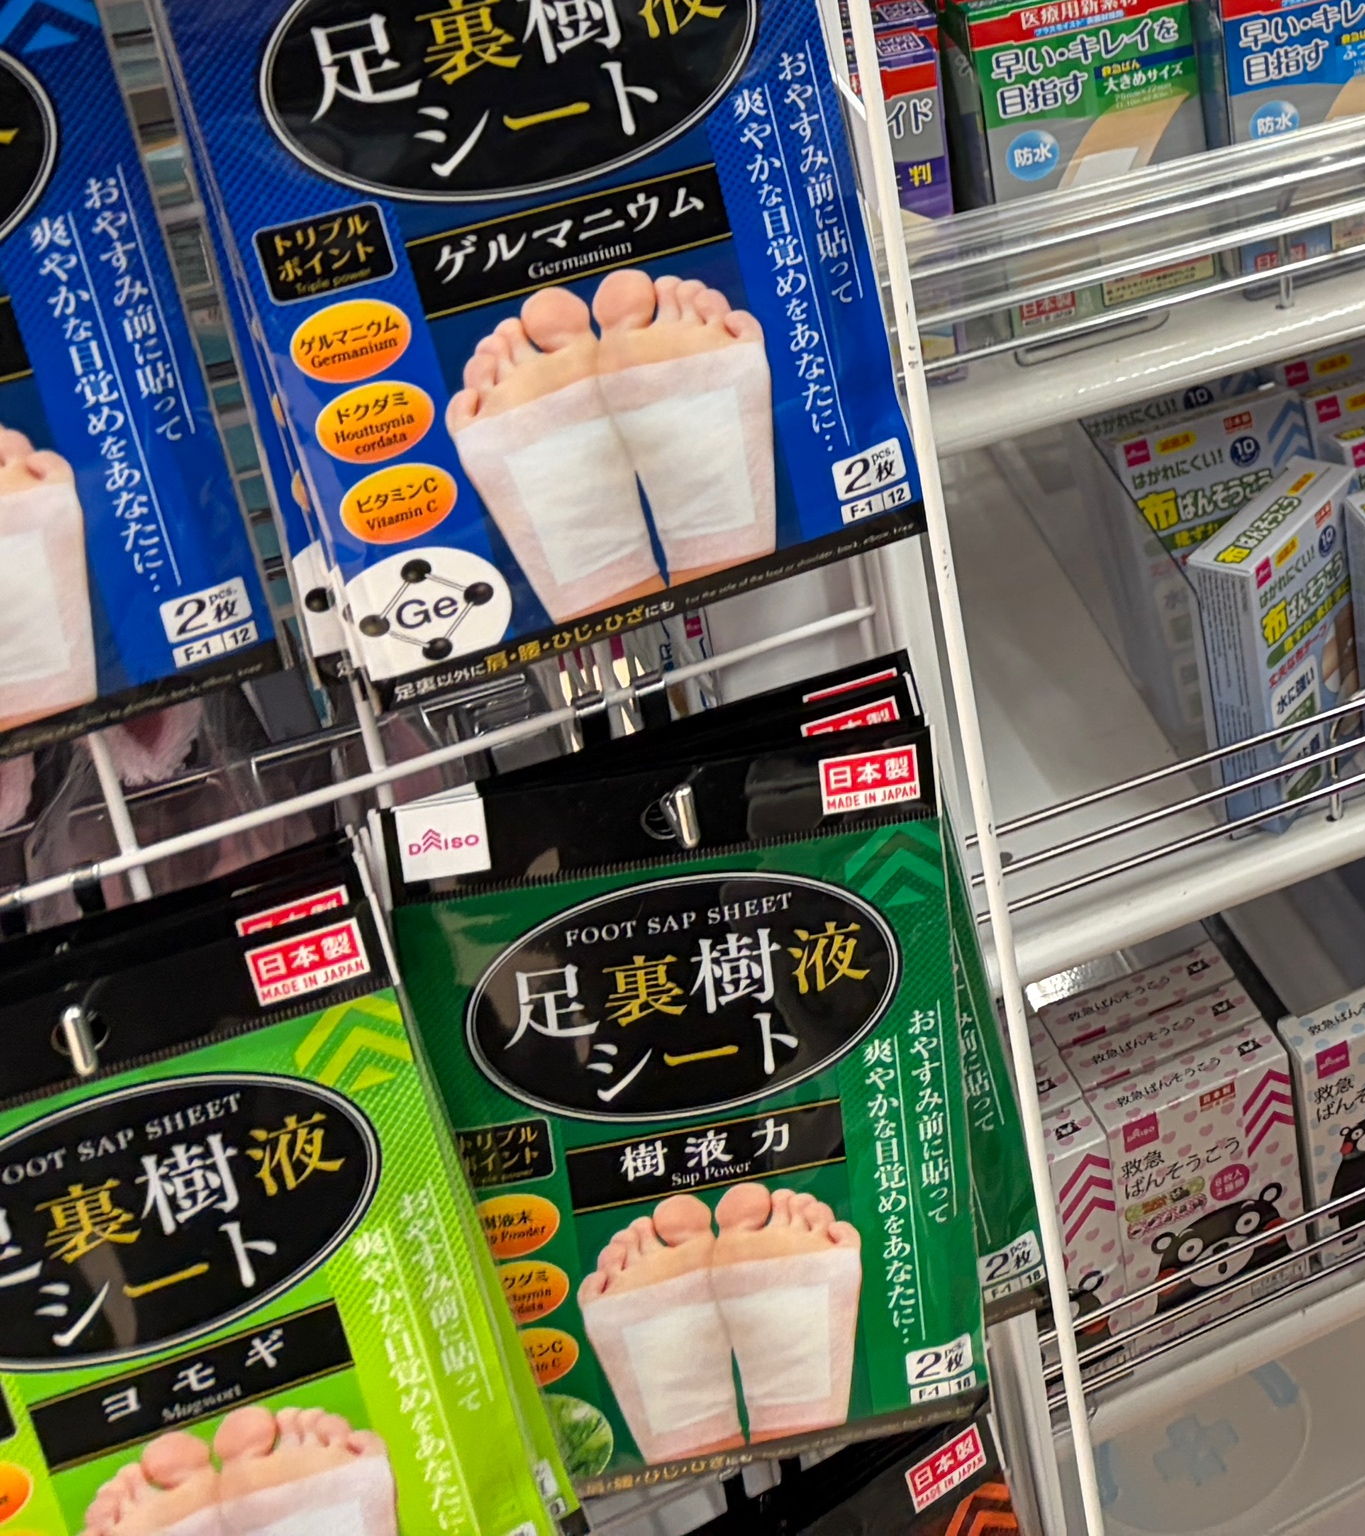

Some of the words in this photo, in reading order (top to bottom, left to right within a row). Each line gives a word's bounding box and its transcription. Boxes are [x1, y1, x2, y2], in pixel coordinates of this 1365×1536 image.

[991, 17, 1179, 83] 早い・キレイを
[1243, 40, 1328, 85] 目指す
[996, 68, 1088, 120] 目指す
[1102, 62, 1184, 96] 大きめサイズ
[413, 62, 658, 177] シート
[1257, 111, 1294, 135] 防水
[1013, 144, 1053, 166] 防水
[779, 51, 852, 305] おやすみ前に貼って
[432, 188, 704, 284] ゲルマニウム
[277, 240, 375, 283] ポイント
[528, 239, 633, 280] Germanium
[83, 178, 182, 442] おやすみ前に貼って
[298, 315, 400, 356] ゲルマニウム
[310, 336, 398, 369] Germanium
[333, 412, 416, 444] Houttuynia
[336, 391, 410, 425] ドクダミ
[354, 432, 409, 456] cordata
[356, 477, 439, 514] ビタミンC
[395, 594, 459, 631] Ge
[826, 755, 912, 791] 日本製
[826, 793, 860, 811] MADE
[864, 791, 877, 806] IN
[881, 784, 918, 804] JAPAN
[408, 828, 480, 857] DAISO
[564, 919, 638, 949] FOOT
[646, 910, 698, 937] SAP
[706, 891, 793, 926] SHEET
[257, 932, 352, 979] 日本製
[261, 981, 298, 1003] MADE
[302, 976, 317, 991] IN
[322, 959, 365, 985] JAPAN
[504, 919, 870, 1052] 足裏樹液
[586, 1012, 800, 1103] シート
[1314, 1077, 1354, 1104] 救急
[910, 1009, 950, 1224] おやすみ前に貼って
[2, 1151, 67, 1186] OOT
[77, 1131, 135, 1158] SAP
[144, 1092, 243, 1143] SHEET
[619, 1117, 790, 1182] 樹液力
[1121, 1149, 1166, 1180] 救急
[1123, 1136, 1241, 1200] ばんそうこう
[33, 1221, 278, 1347] シート
[102, 1328, 286, 1424] ヨモギ
[161, 1383, 243, 1425] Mugwort
[911, 1439, 977, 1493] 日本製
